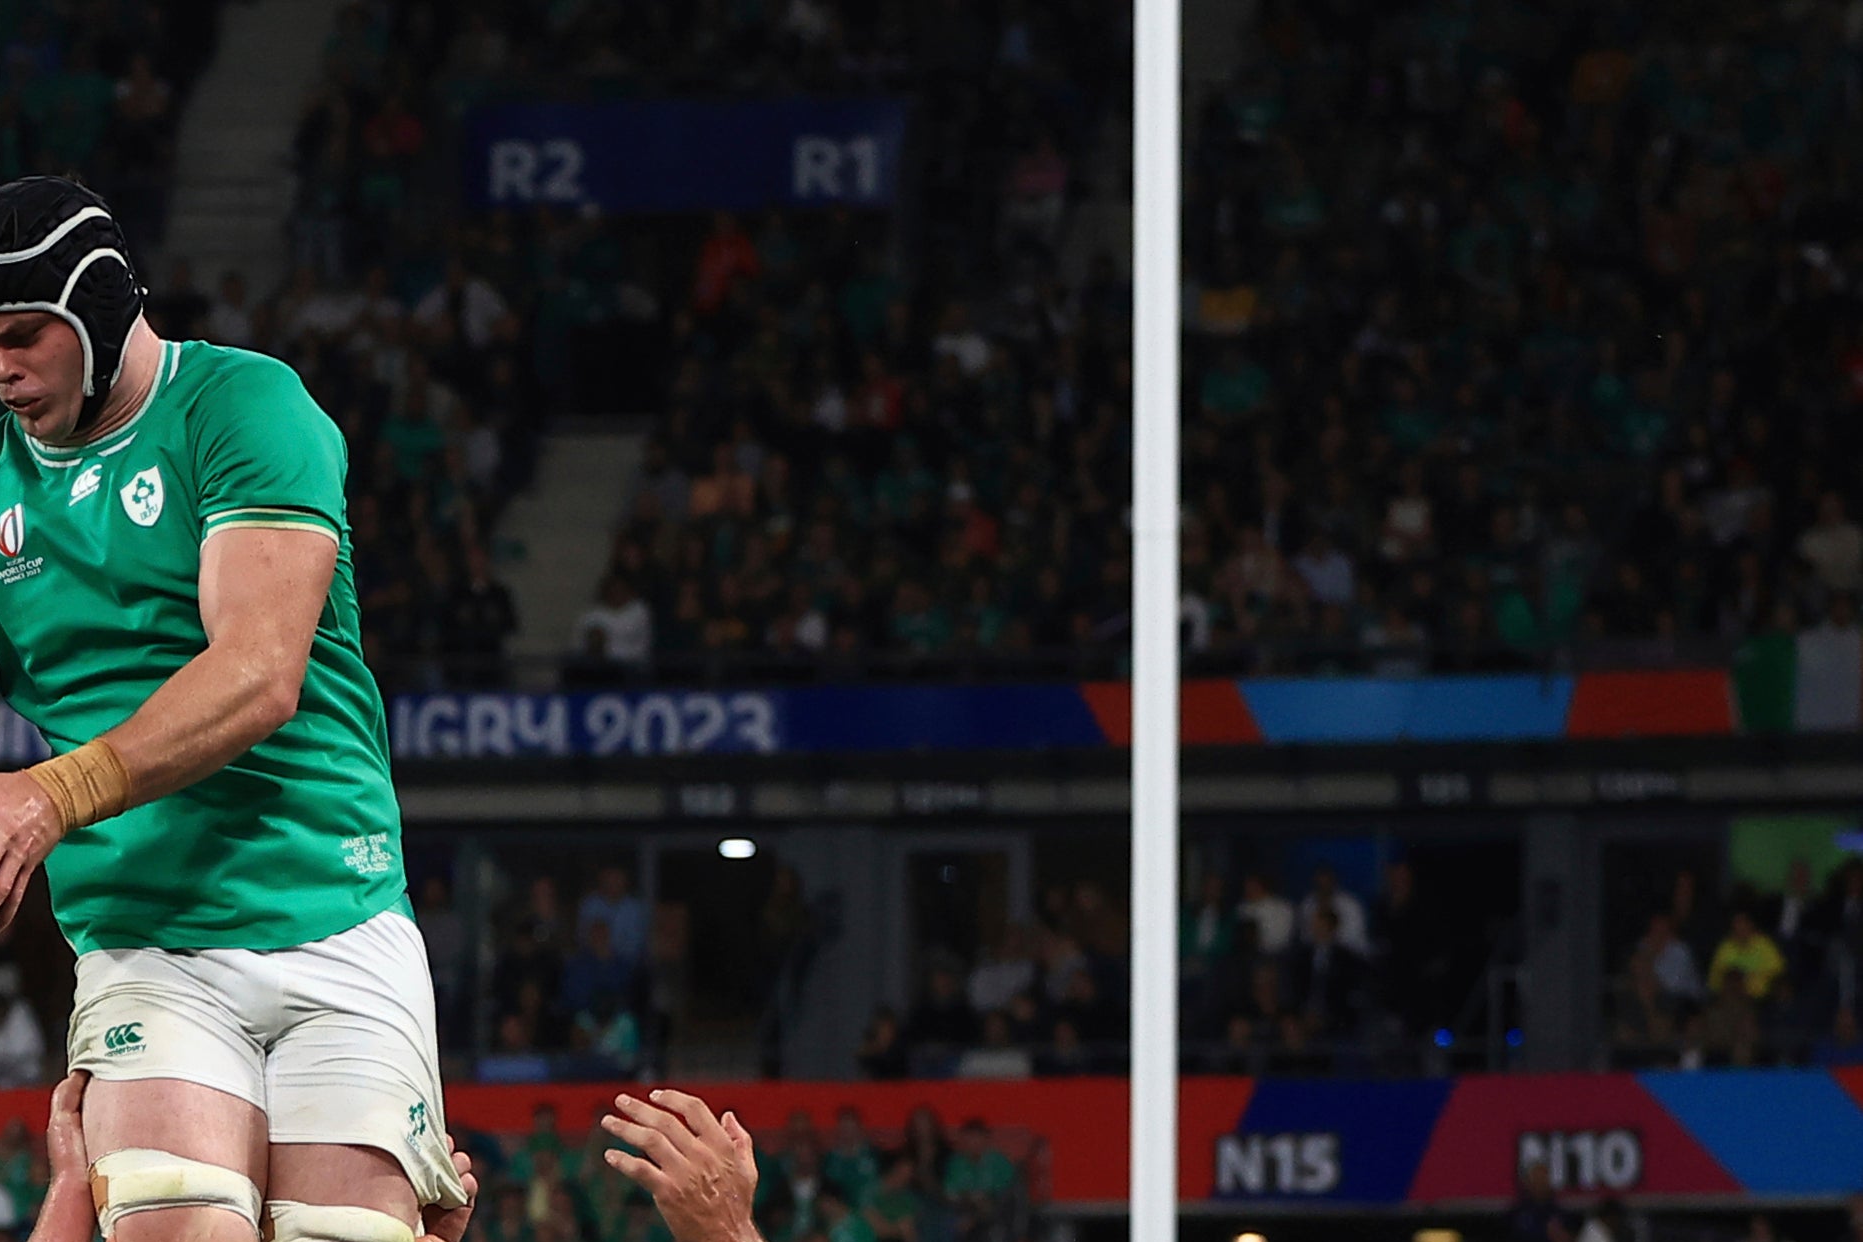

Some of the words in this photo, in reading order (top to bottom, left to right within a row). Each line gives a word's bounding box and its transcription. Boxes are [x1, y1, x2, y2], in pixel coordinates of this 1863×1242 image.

[489, 139, 584, 198] R2
[792, 136, 878, 197] R1
[26, 556, 44, 569] CUP
[1217, 1134, 1338, 1192] N15
[1519, 1131, 1638, 1191] N10
